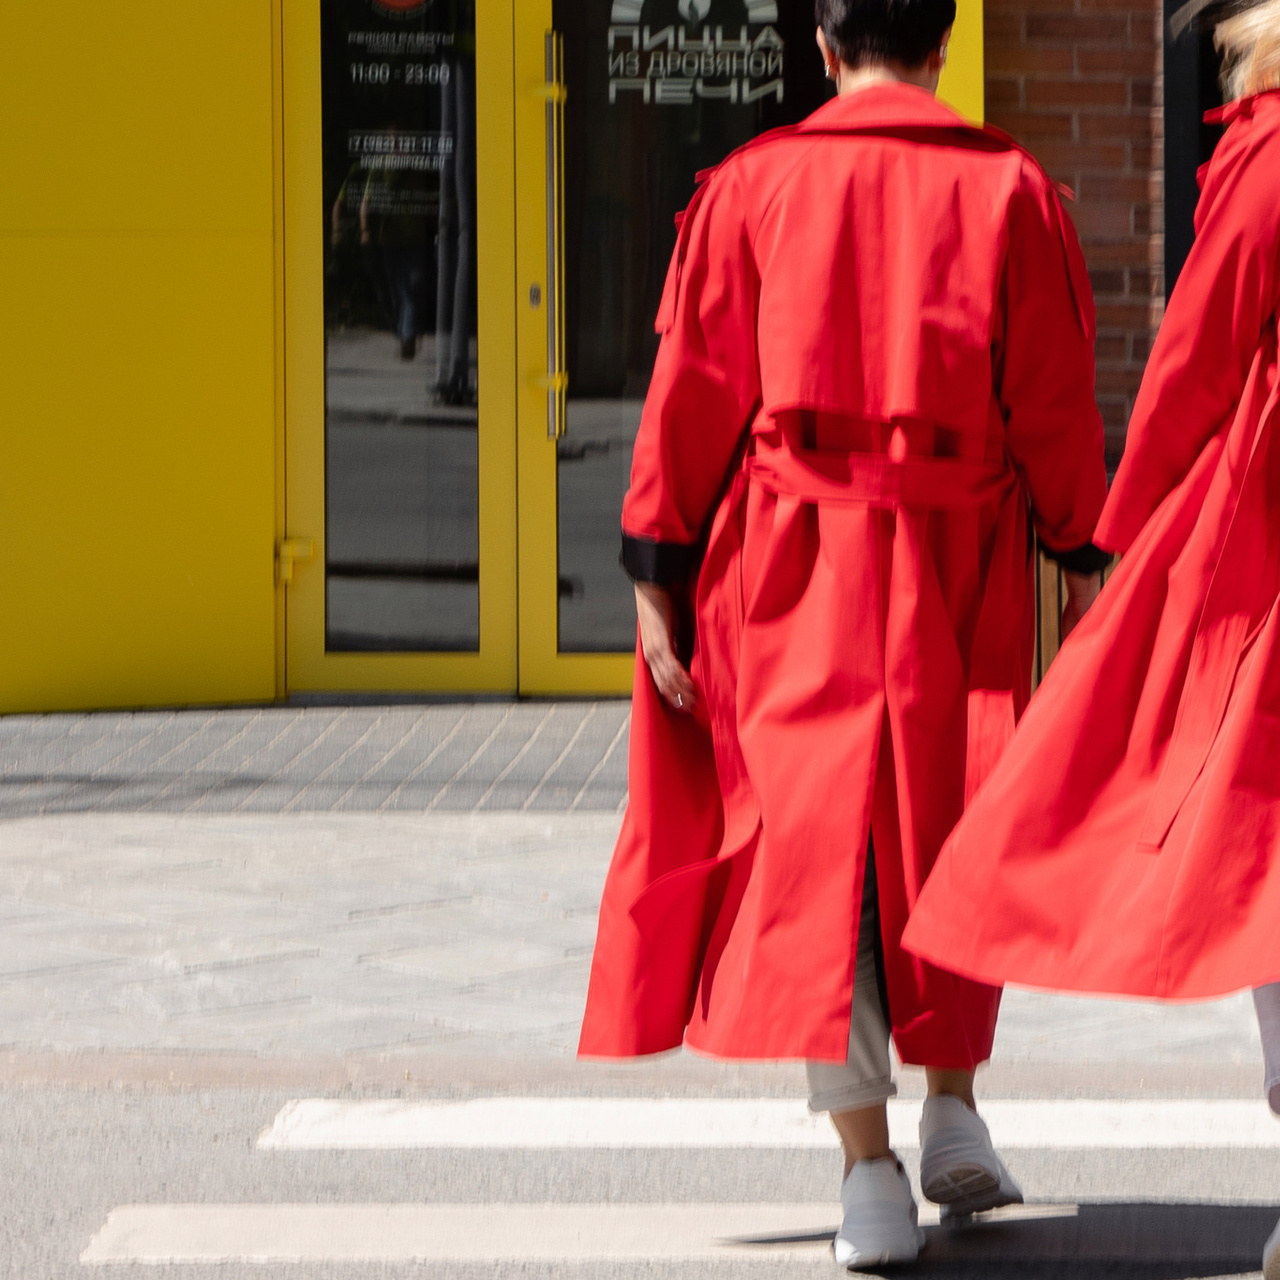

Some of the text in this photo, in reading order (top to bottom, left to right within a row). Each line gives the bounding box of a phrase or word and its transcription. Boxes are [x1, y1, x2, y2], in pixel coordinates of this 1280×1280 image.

[607, 24, 785, 54] ПИЦЦА
[350, 62, 390, 85] 11:00
[405, 62, 450, 85] 23:00
[608, 50, 784, 79] ИЗ ДРОВЯНОЙ
[608, 78, 785, 105] ПЕЧИ
